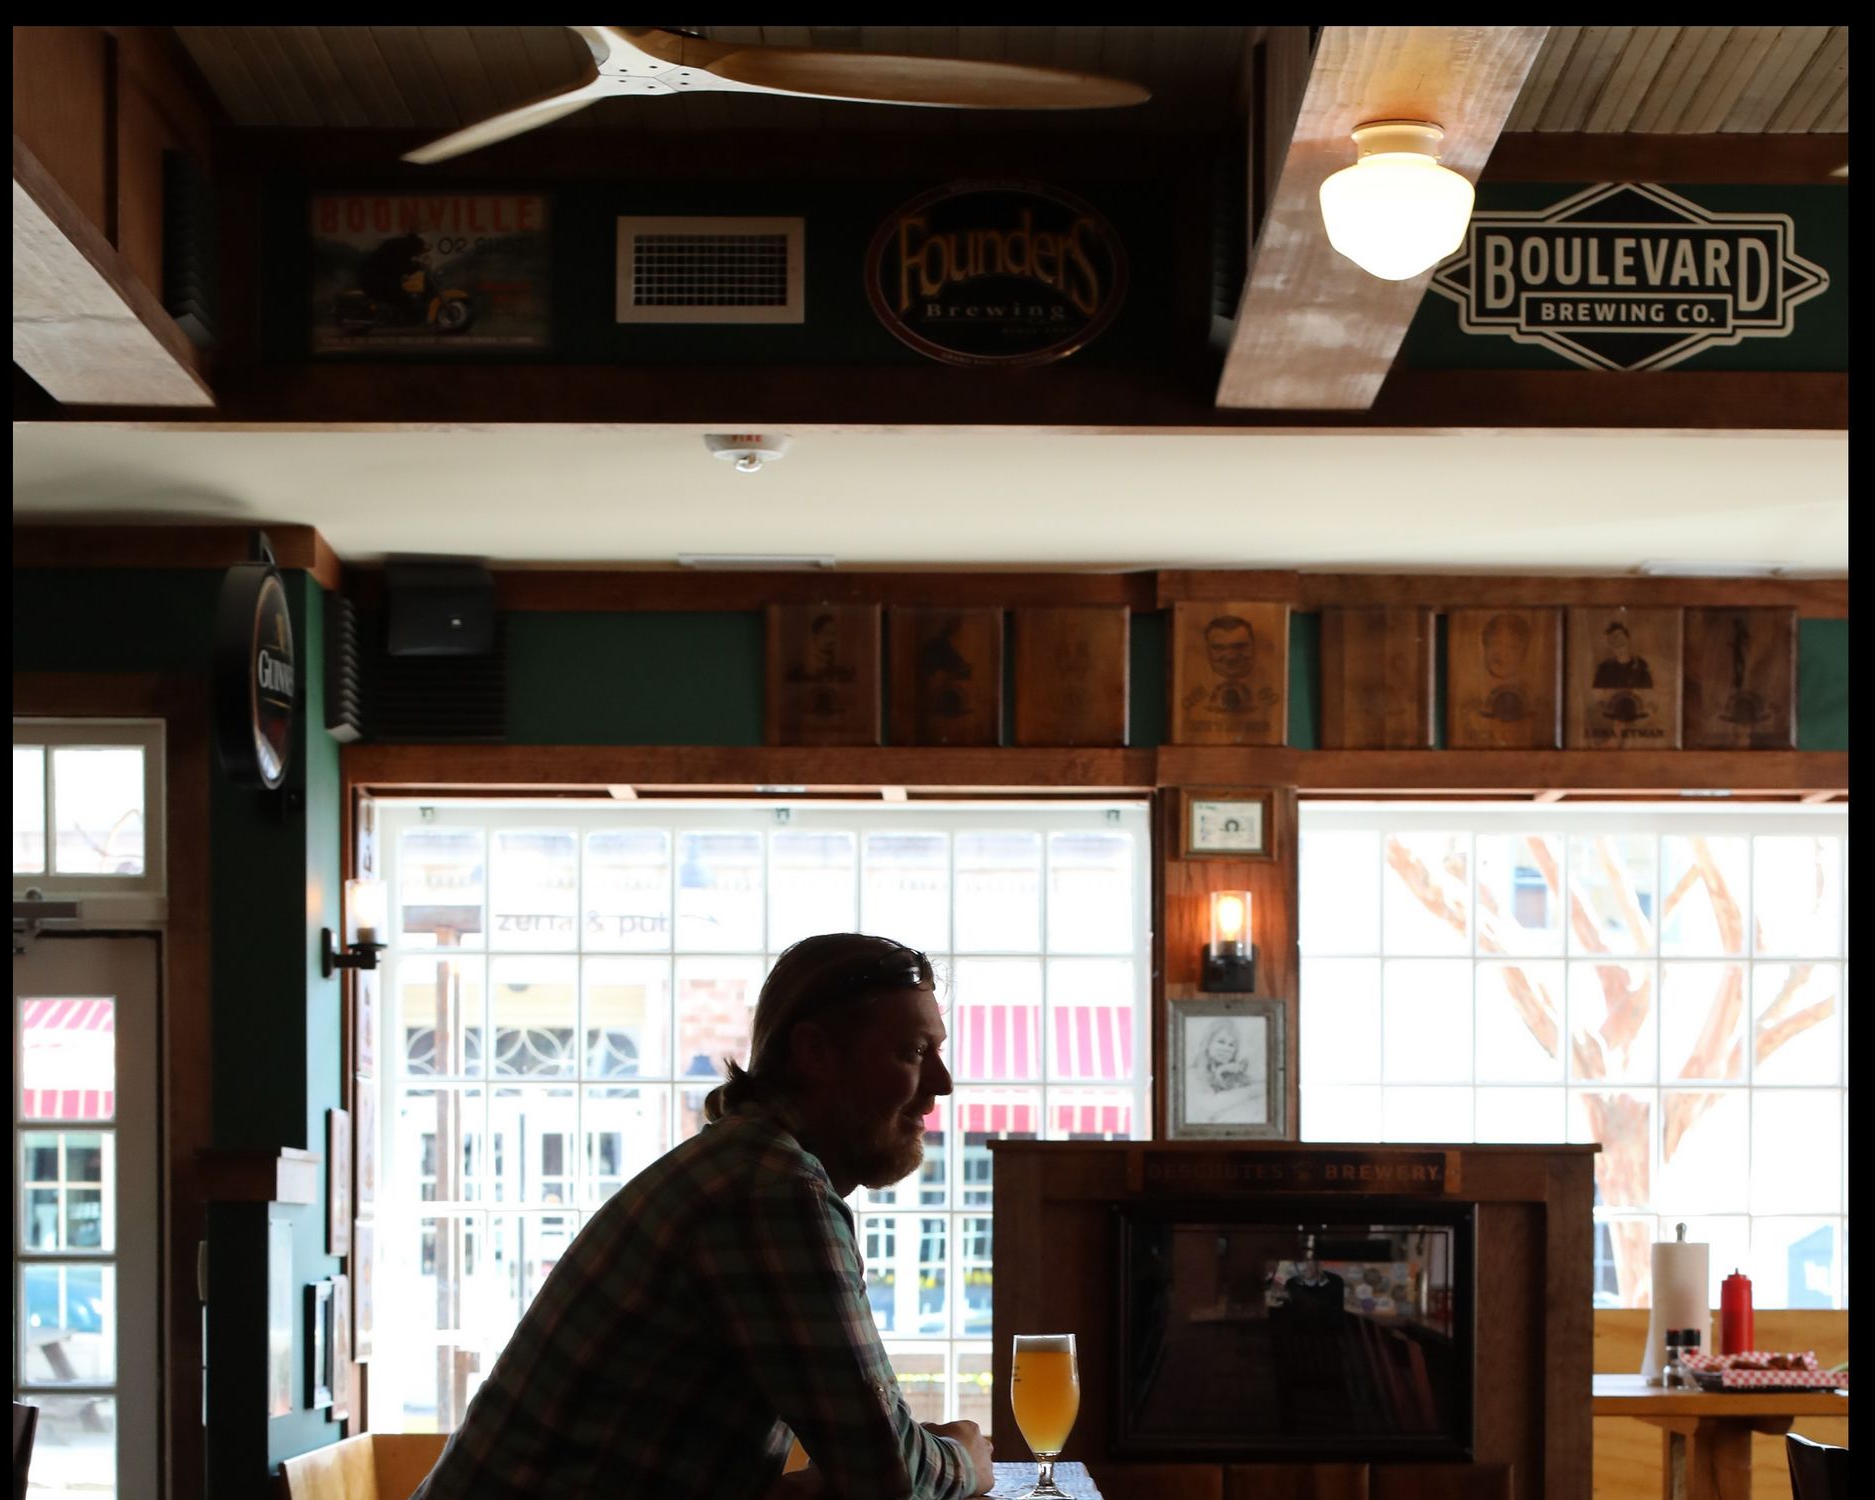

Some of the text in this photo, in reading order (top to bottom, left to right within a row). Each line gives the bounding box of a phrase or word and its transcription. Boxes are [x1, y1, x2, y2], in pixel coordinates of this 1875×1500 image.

[319, 197, 536, 233] BOONVILLE
[1484, 233, 1771, 312] BOULEVARD
[924, 297, 1067, 320] Brewing
[1540, 301, 1717, 324] BREWING CO.
[1147, 1163, 1440, 1183] DESCHUTES BREWERY
